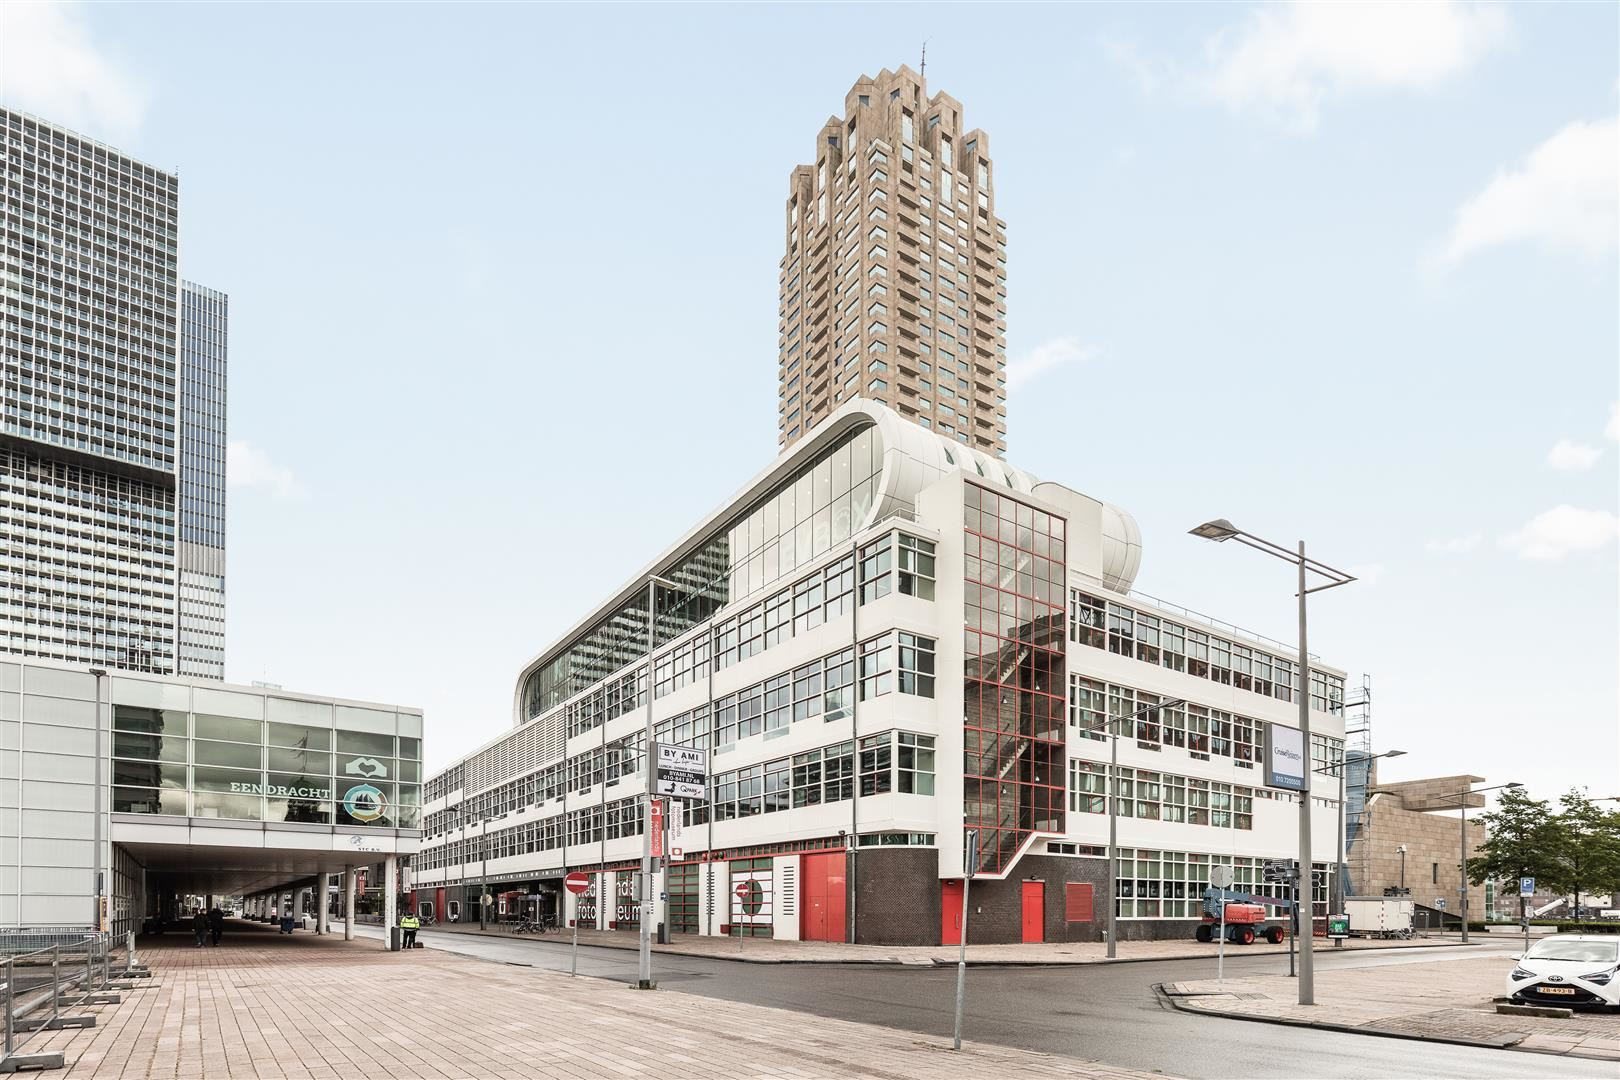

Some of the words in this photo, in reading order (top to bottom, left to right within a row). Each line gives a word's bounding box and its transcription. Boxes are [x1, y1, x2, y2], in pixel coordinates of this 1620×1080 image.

[664, 749, 676, 758] BY
[681, 752, 699, 761] AMI
[230, 782, 331, 799] EENDRACHT
[1523, 879, 1532, 887] P
